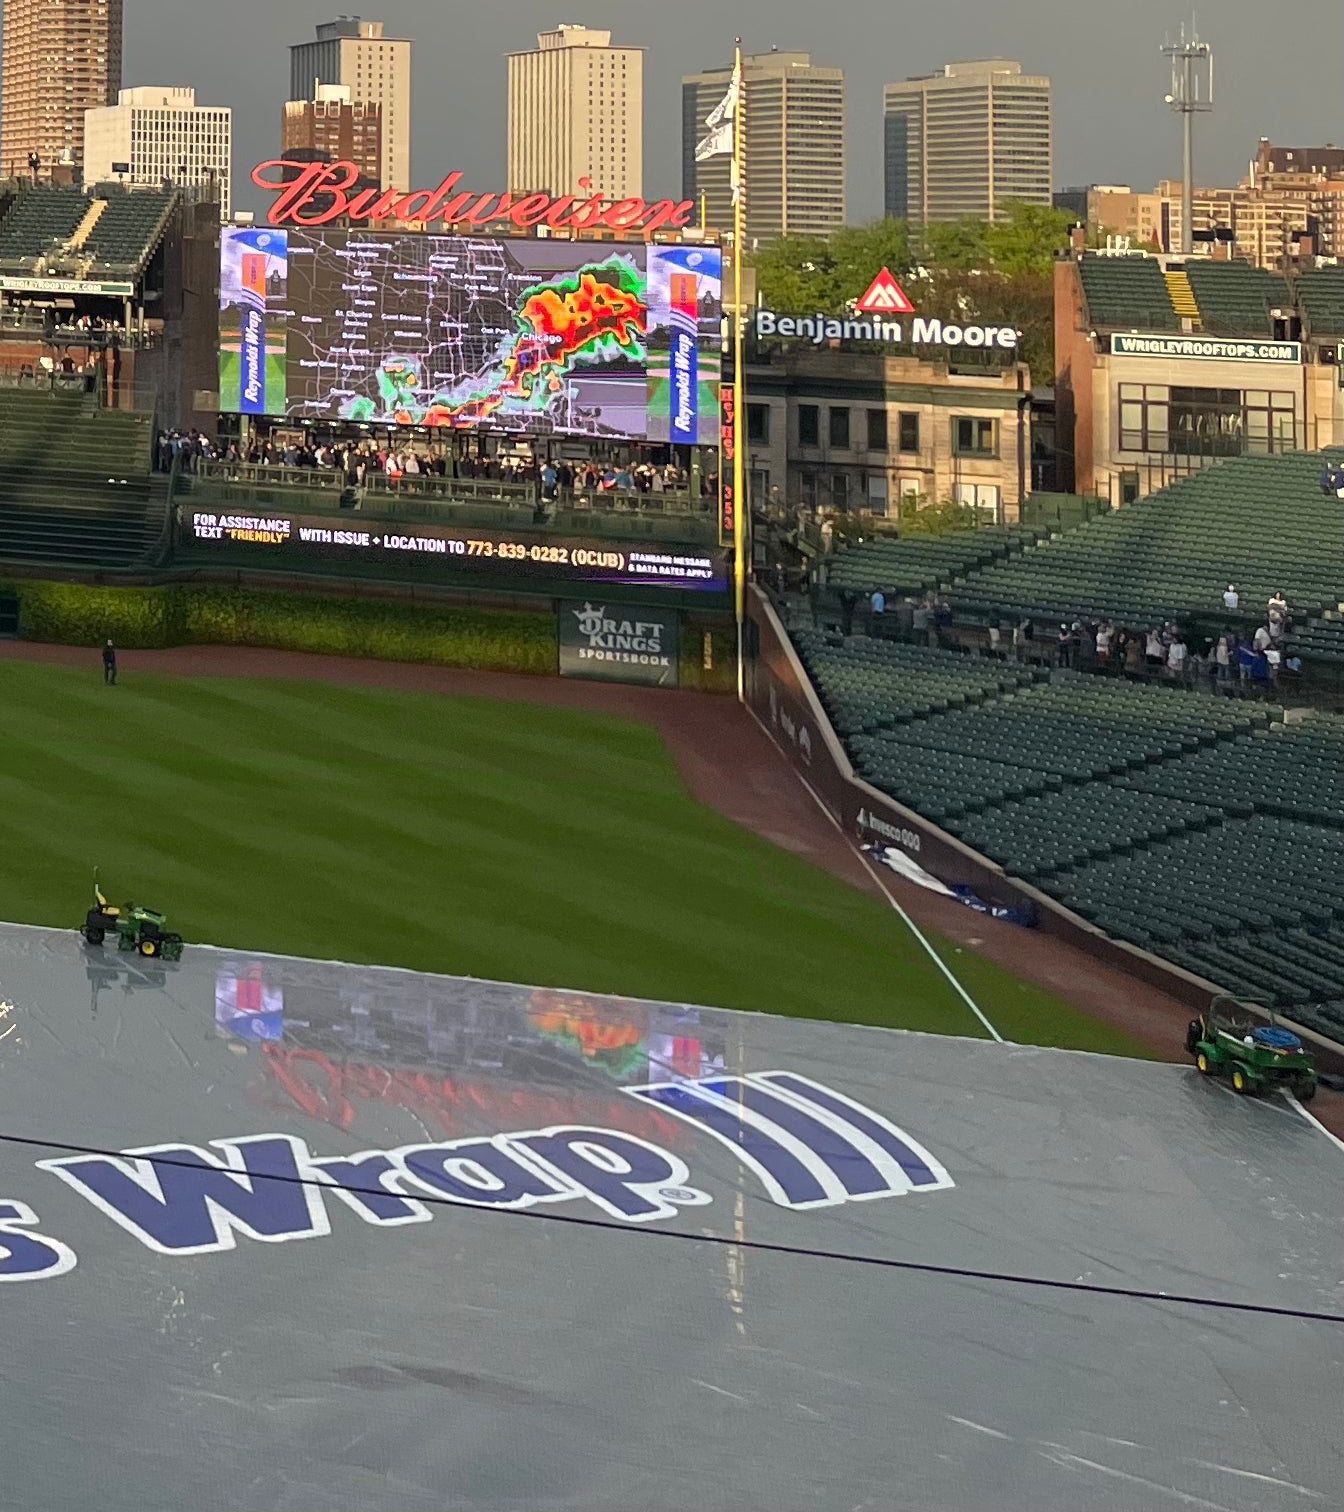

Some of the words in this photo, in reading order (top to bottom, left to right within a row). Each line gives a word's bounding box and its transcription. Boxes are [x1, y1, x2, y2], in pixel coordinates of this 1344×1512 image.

[251, 159, 693, 231] Budweiser
[245, 310, 262, 345] Wrap
[521, 332, 562, 343] Chicago
[756, 311, 901, 344] Benjamin
[912, 317, 1016, 347] Moore
[675, 333, 694, 371] Wrap
[1121, 338, 1291, 359] WRIGLEYROOFTOPS.COM
[244, 344, 262, 403] Reynolds
[674, 371, 695, 432] Reynolds
[193, 513, 216, 526] FOR
[219, 515, 290, 532] ASSISTANCE
[194, 525, 223, 538] TEXT
[226, 528, 289, 543] "FRIENDLY"
[299, 527, 331, 542] WITH
[334, 531, 369, 546] ISSUE
[384, 535, 445, 553] LOCATION
[447, 541, 464, 554] TO
[467, 540, 568, 564] 773-839-0282
[579, 618, 664, 638] DRAFT
[589, 632, 661, 652] KINGS
[579, 648, 669, 666] SPORTSBOOK
[36, 1124, 690, 1255] Wrap
